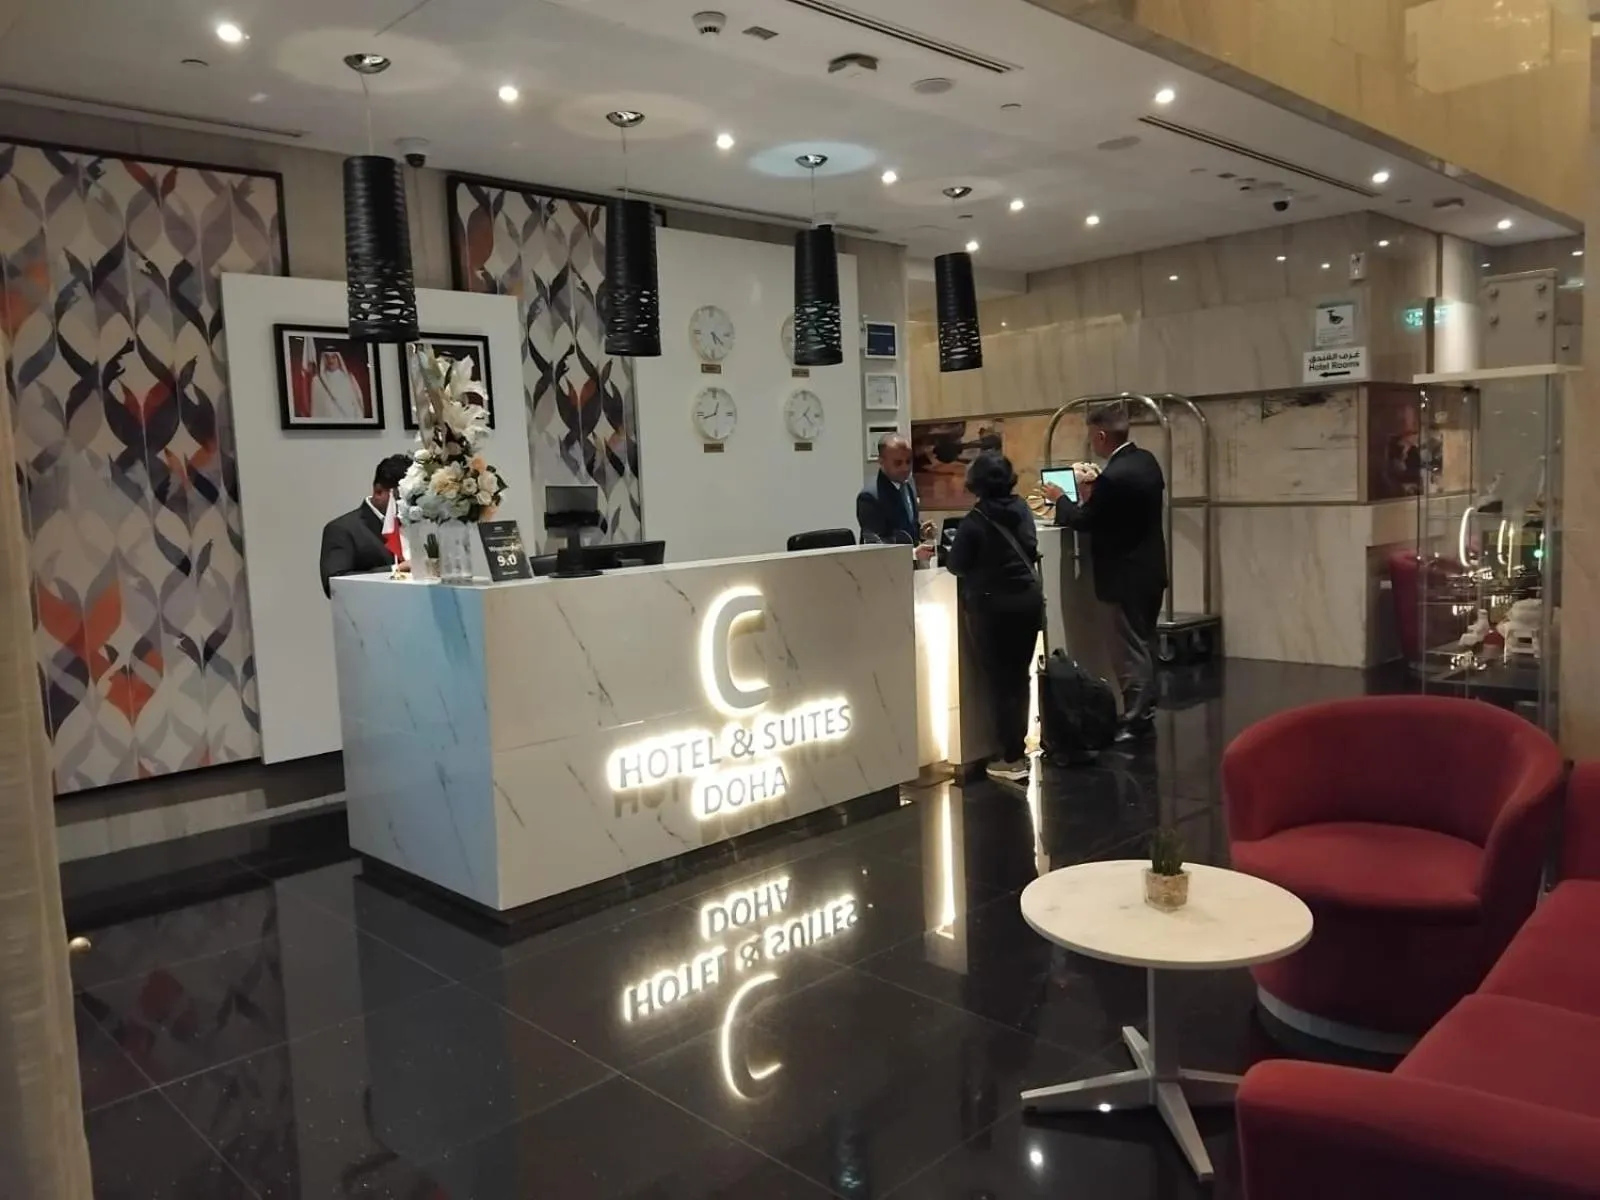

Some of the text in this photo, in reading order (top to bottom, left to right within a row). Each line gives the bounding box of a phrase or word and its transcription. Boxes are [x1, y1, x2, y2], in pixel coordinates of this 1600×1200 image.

[1308, 361, 1360, 371] Hotel Rooms
[496, 553, 518, 567] 9.0
[711, 593, 770, 710] C
[618, 704, 852, 789] HOTEL & SUITES
[703, 766, 790, 815] DOHA
